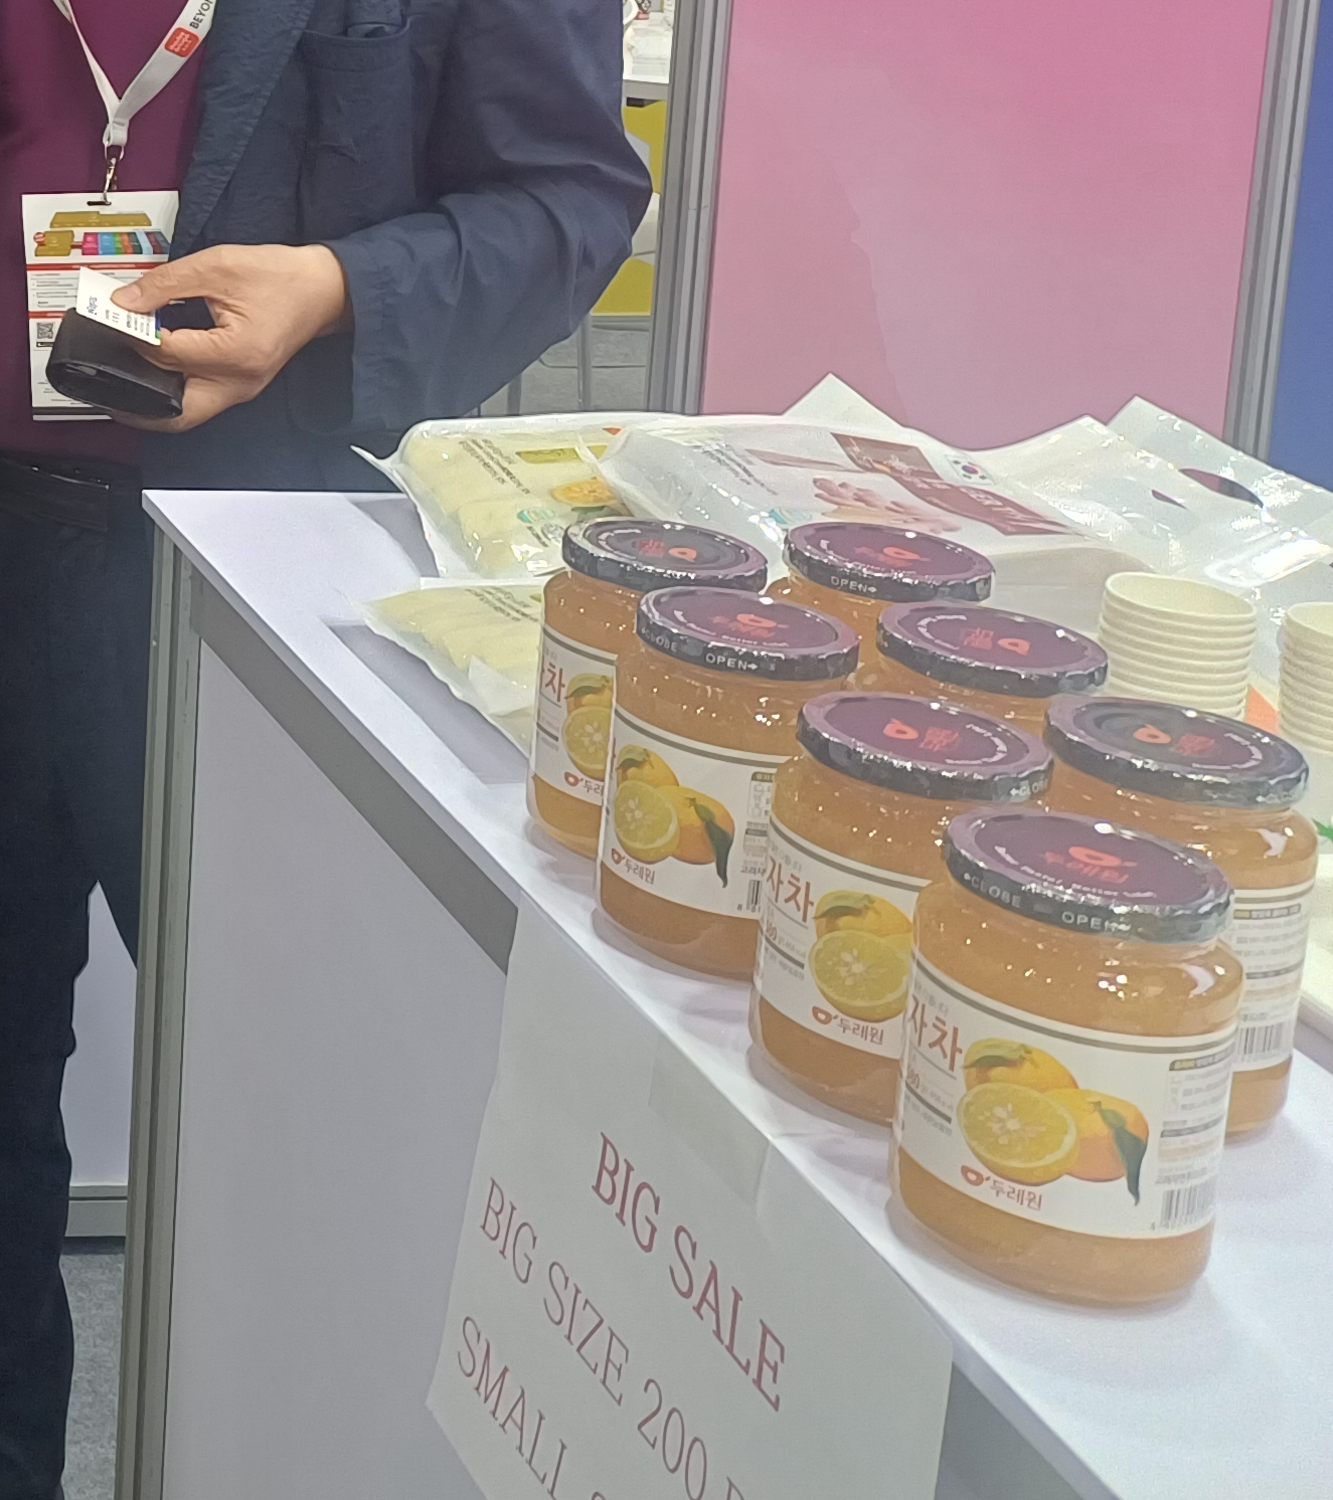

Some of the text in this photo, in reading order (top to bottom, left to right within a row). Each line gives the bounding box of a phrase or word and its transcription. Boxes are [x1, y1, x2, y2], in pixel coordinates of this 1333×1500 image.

[705, 652, 748, 671] OPEN
[836, 1017, 884, 1046] 두레원
[989, 1178, 1043, 1212] 두레원
[591, 1132, 786, 1412] BIG SALE
[480, 1177, 708, 1500] BIG SIZE 200
[457, 1316, 568, 1500] SMALL
